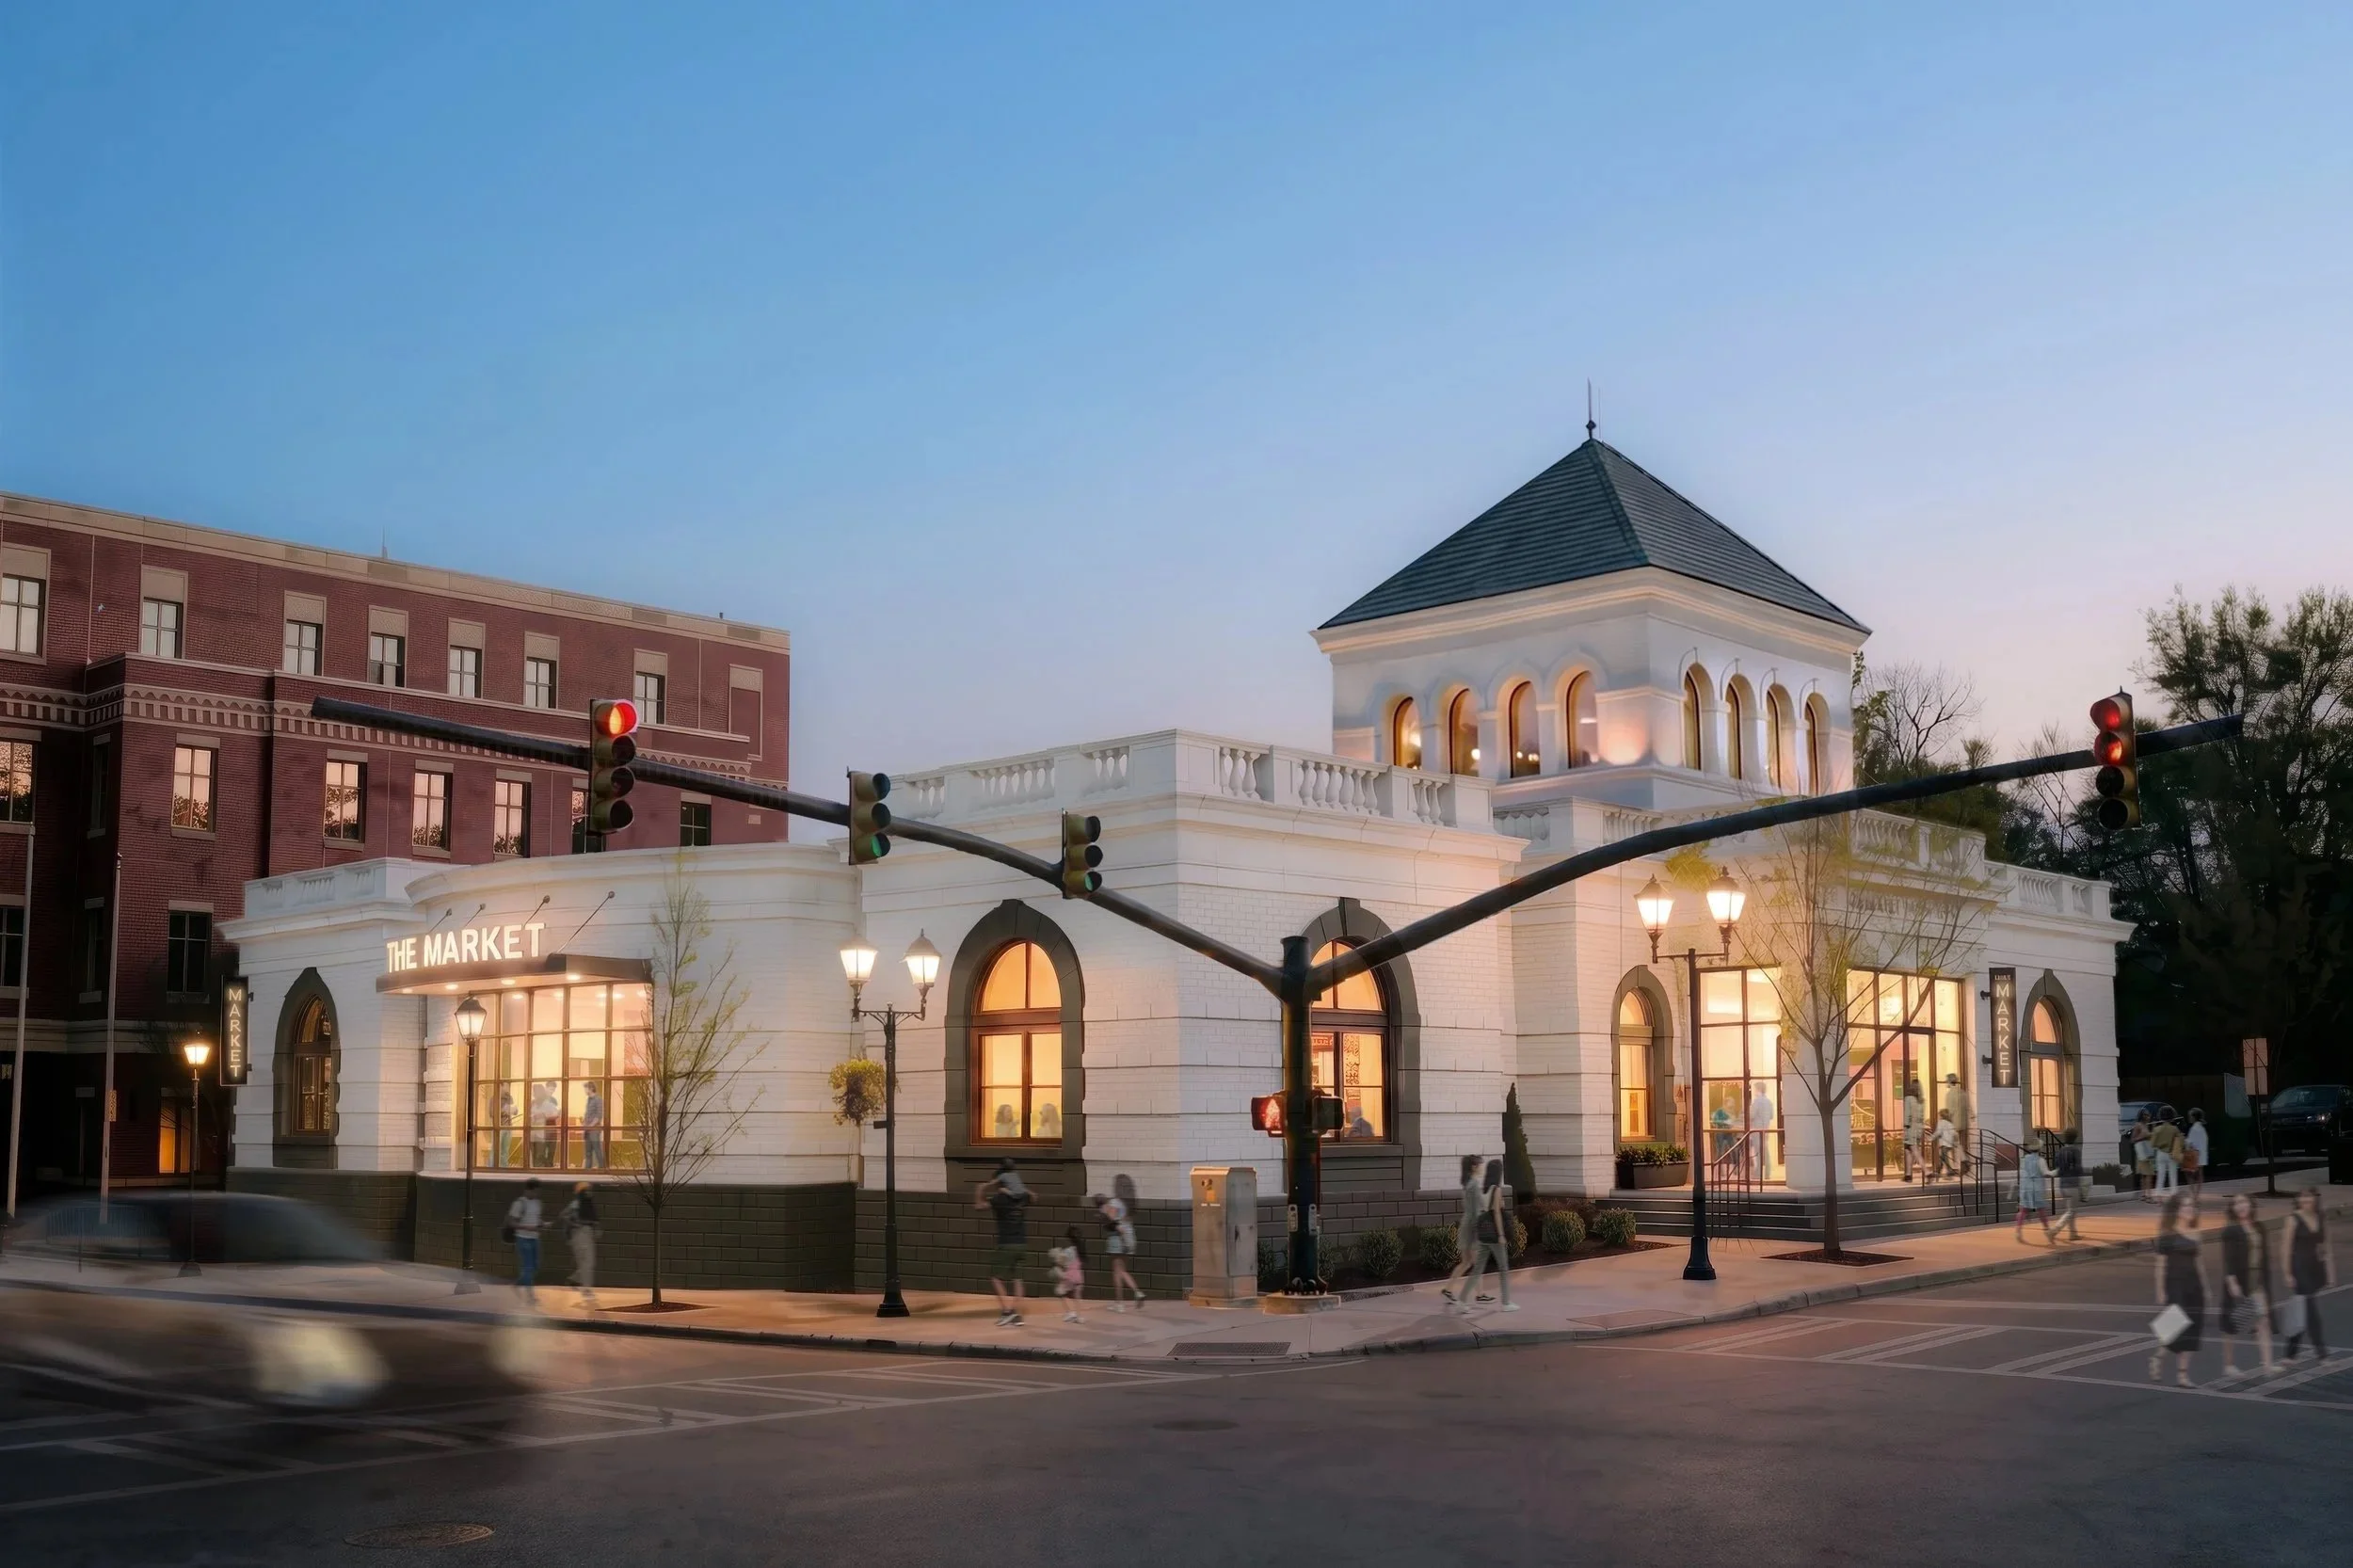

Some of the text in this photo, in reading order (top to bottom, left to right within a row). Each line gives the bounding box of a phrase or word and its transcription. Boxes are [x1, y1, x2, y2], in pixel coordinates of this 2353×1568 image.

[387, 922, 545, 973] THE MARKET
[229, 988, 242, 1078] MARKET
[1996, 983, 2010, 1085] MARKET
